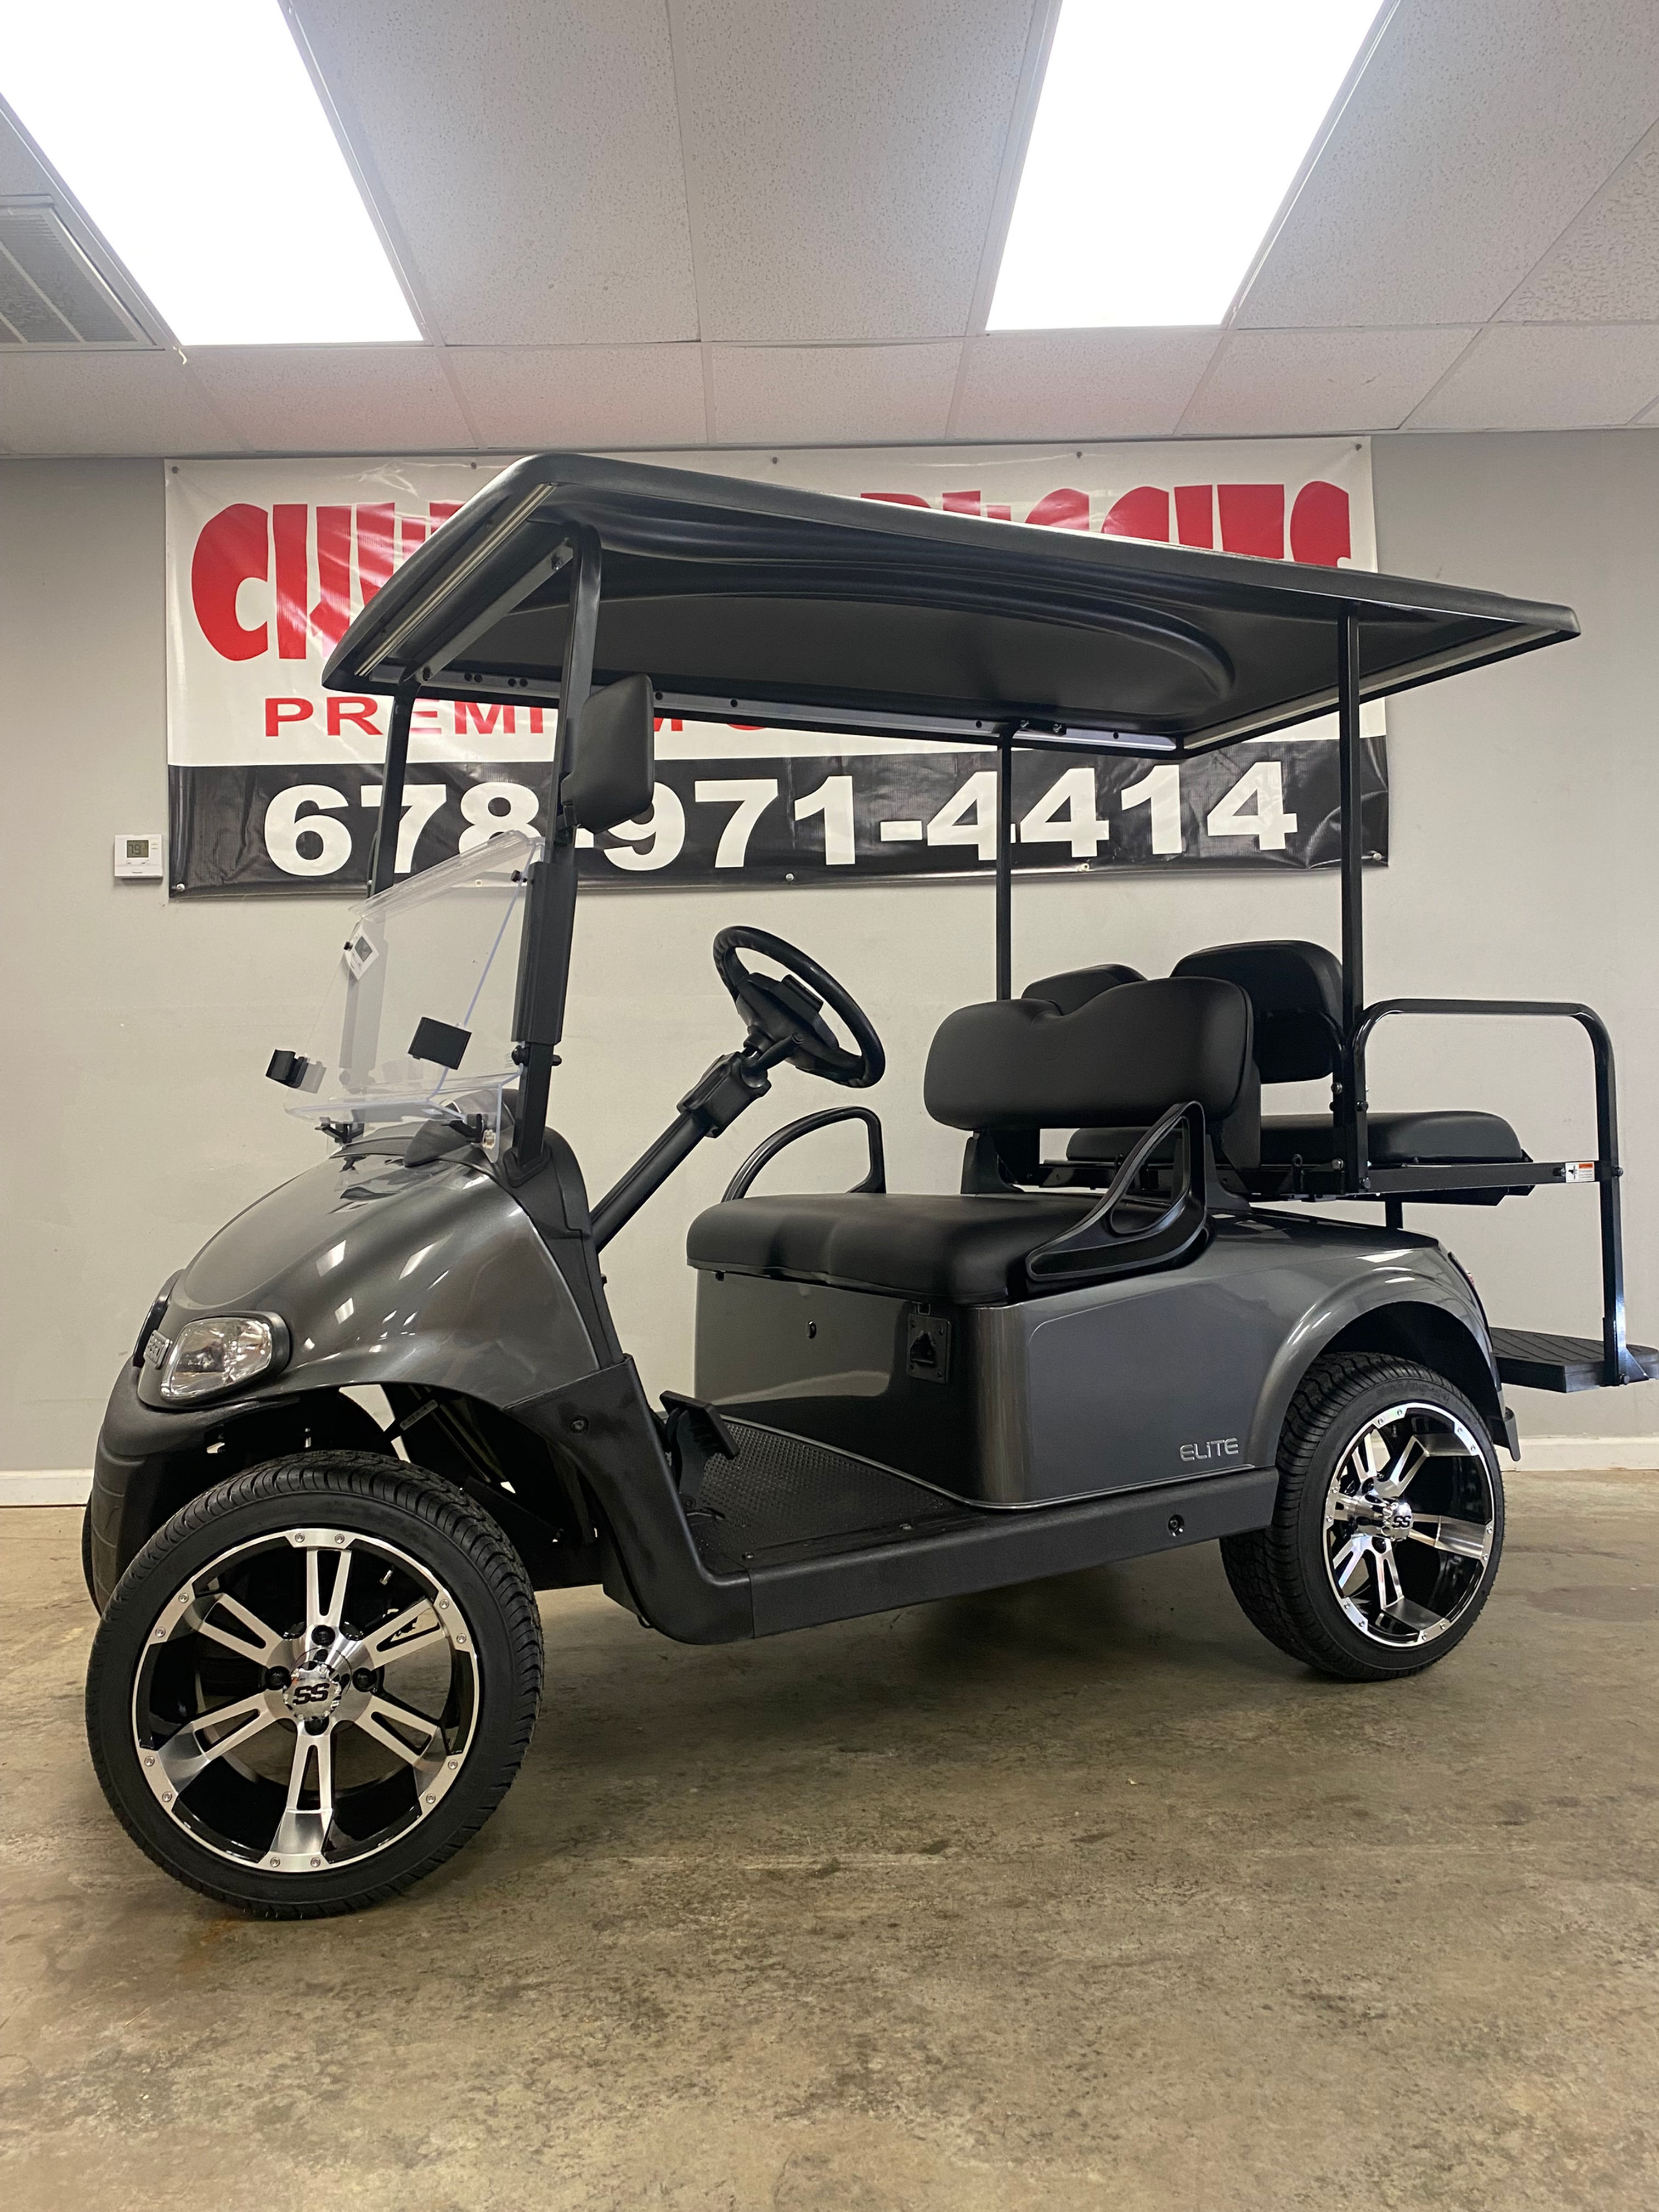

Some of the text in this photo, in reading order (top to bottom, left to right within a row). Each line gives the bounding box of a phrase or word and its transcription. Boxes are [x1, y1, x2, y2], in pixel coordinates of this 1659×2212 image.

[265, 696, 683, 736] PREMI
[1392, 1515, 1412, 1528] SS
[292, 1683, 330, 1705] SS
